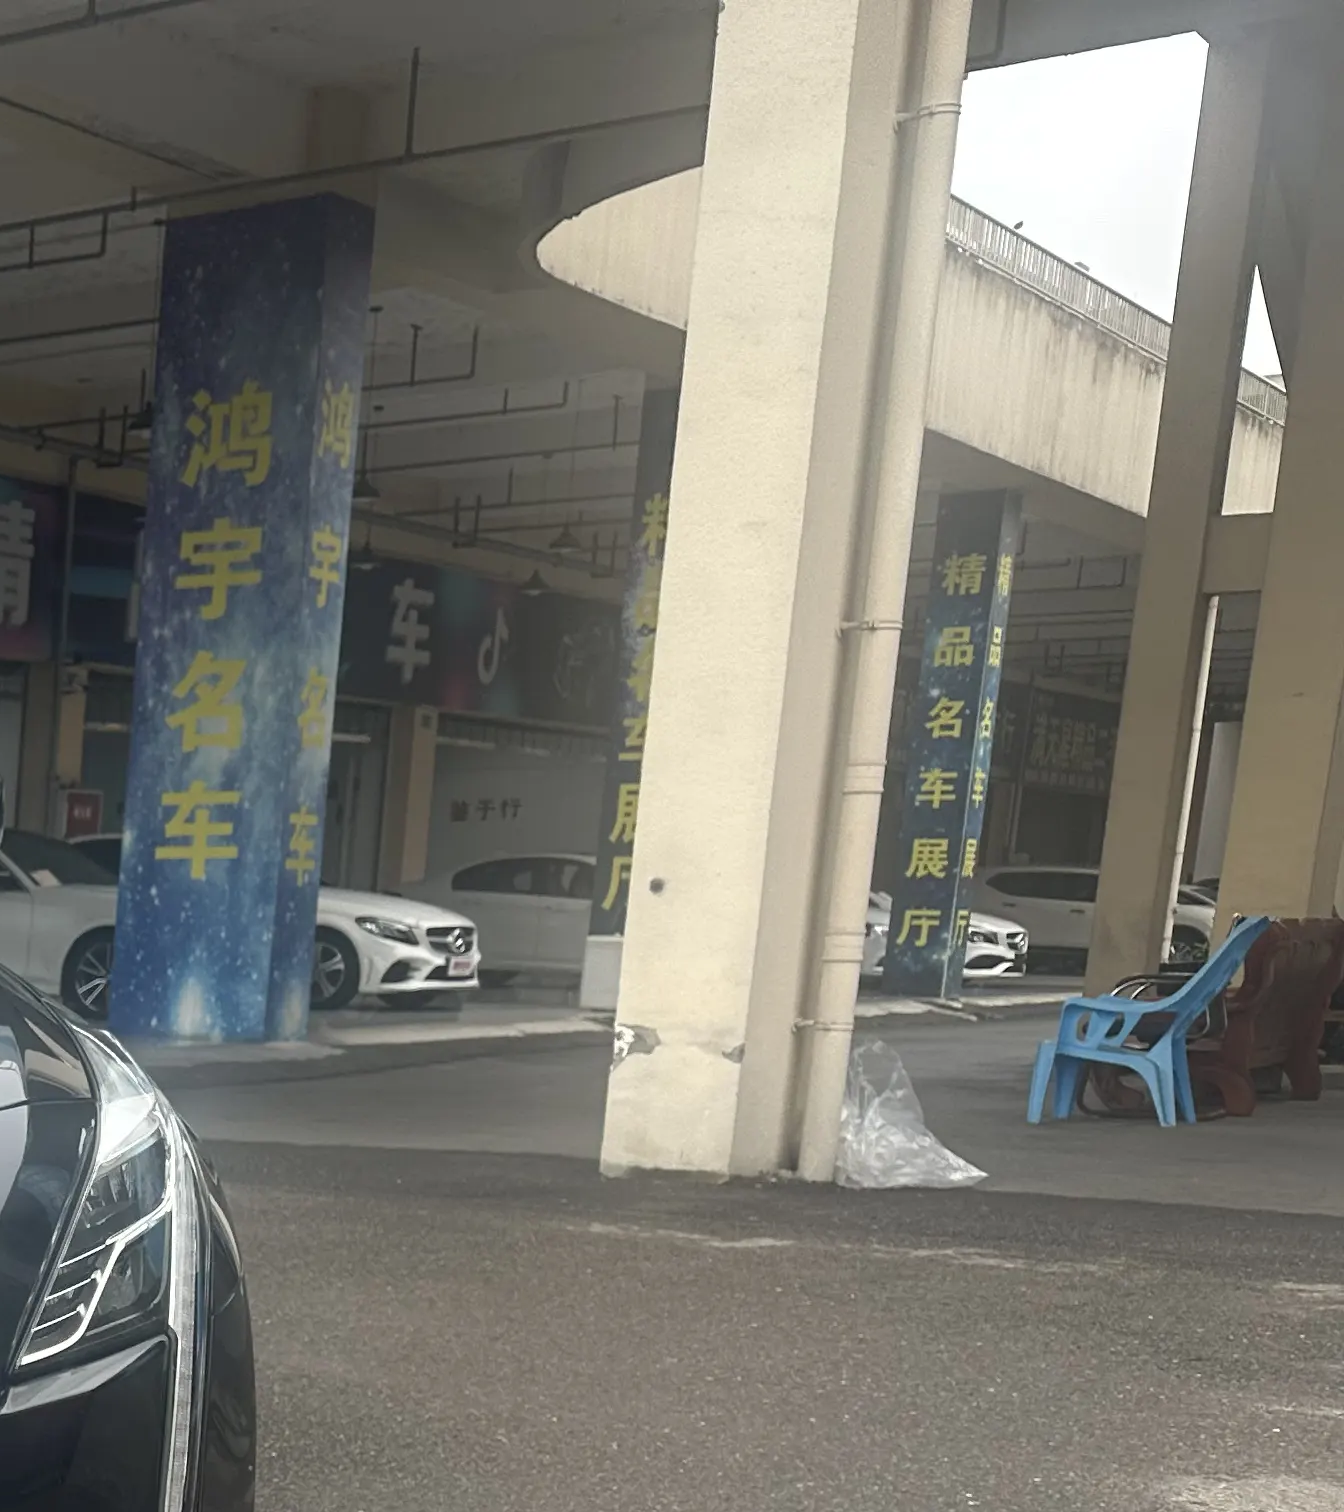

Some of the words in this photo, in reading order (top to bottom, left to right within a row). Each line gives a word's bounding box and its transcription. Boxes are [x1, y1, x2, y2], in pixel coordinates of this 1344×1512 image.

[154, 378, 275, 883] 鸿宇名车
[285, 375, 356, 888] 鸿宇名车
[896, 552, 987, 948] 精品名车展厅
[953, 552, 1015, 946] 精品名车展厅
